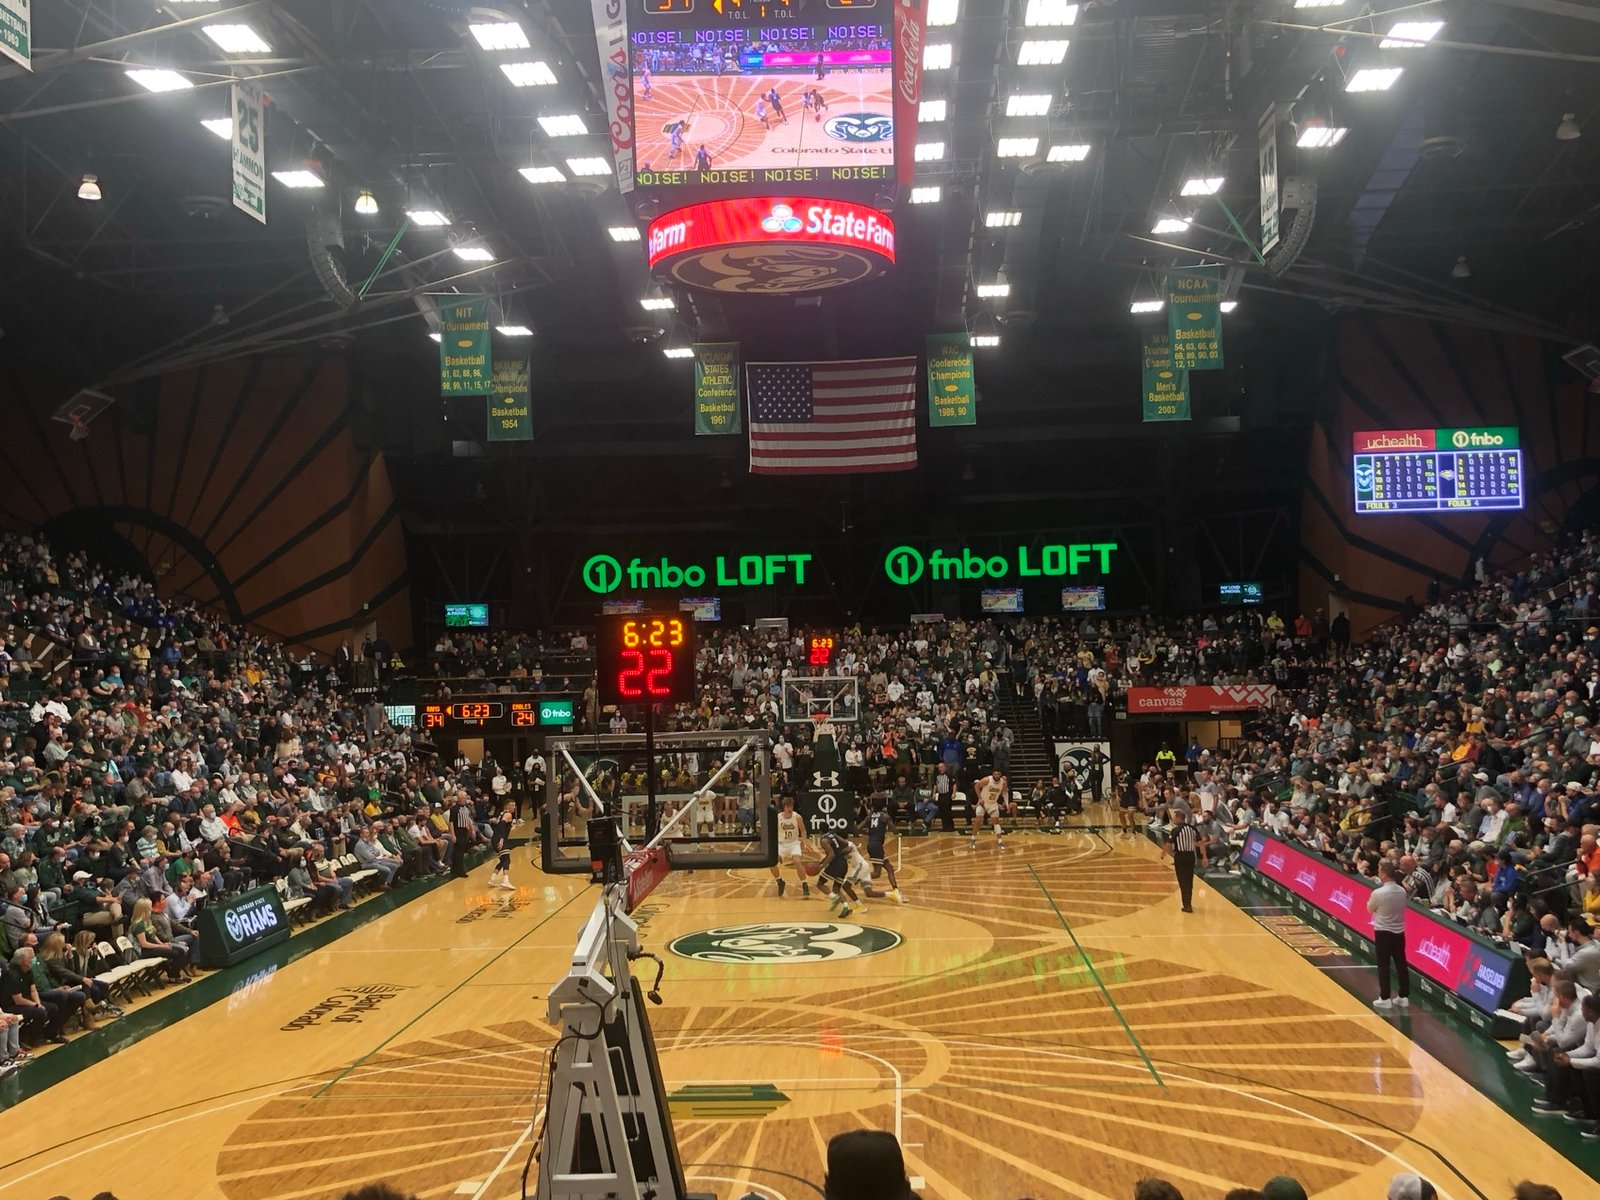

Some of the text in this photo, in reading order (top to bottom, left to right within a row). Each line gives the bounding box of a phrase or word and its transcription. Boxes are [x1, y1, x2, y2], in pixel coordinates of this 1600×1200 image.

[728, 11, 750, 19] T.O.L.
[774, 10, 795, 18] T.O.L.
[695, 29, 750, 42] NOISE!
[760, 27, 815, 40] NOISE!
[828, 25, 883, 39] NOISE!
[609, 47, 632, 154] Coors
[701, 170, 754, 183] NOISE!
[765, 168, 819, 181] NOISE!
[832, 167, 886, 180] NOISE!
[1177, 278, 1209, 290] NCAA
[1169, 293, 1220, 305] Tournament
[456, 307, 473, 318] NIT
[442, 321, 489, 331] Tournament
[1175, 328, 1216, 340] Basketball
[445, 355, 486, 366] Basketball
[930, 358, 971, 368] Conference
[1187, 360, 1195, 368] 13
[704, 363, 729, 374] STATES
[930, 370, 971, 380] Champions
[464, 381, 473, 391] 11,
[484, 380, 491, 389] 17
[702, 376, 733, 386] ATHLETIC
[698, 388, 737, 397] Conference
[1156, 382, 1177, 392] Men's
[934, 394, 970, 405] Basketball
[1148, 392, 1185, 402] Basketball
[492, 407, 528, 417] Basketball
[700, 403, 736, 412] Basketball
[938, 406, 967, 417] 1989, 90
[1157, 405, 1176, 415] 2003
[501, 419, 518, 429] 1954
[710, 415, 726, 425] 1961
[1367, 433, 1423, 448] uchealth
[1470, 432, 1504, 446] fnbo
[1448, 499, 1471, 507] FOULS
[929, 543, 1118, 580] fnbo LOFT
[627, 554, 812, 588] fnbo LOFT
[623, 620, 683, 648] 6:23
[812, 638, 833, 648] 6:23
[811, 648, 829, 664] 22
[618, 649, 673, 695] 22
[1139, 697, 1183, 707] canvas
[463, 705, 490, 718] 6:23
[552, 709, 571, 718] fnbo
[427, 714, 442, 727] 34
[517, 712, 533, 726] 24
[240, 904, 278, 937] RAMS
[1419, 936, 1450, 968] uchealth
[1477, 964, 1505, 990] HASELDEN
[280, 995, 359, 1031] Colorado
[331, 994, 397, 1023] Bank of
